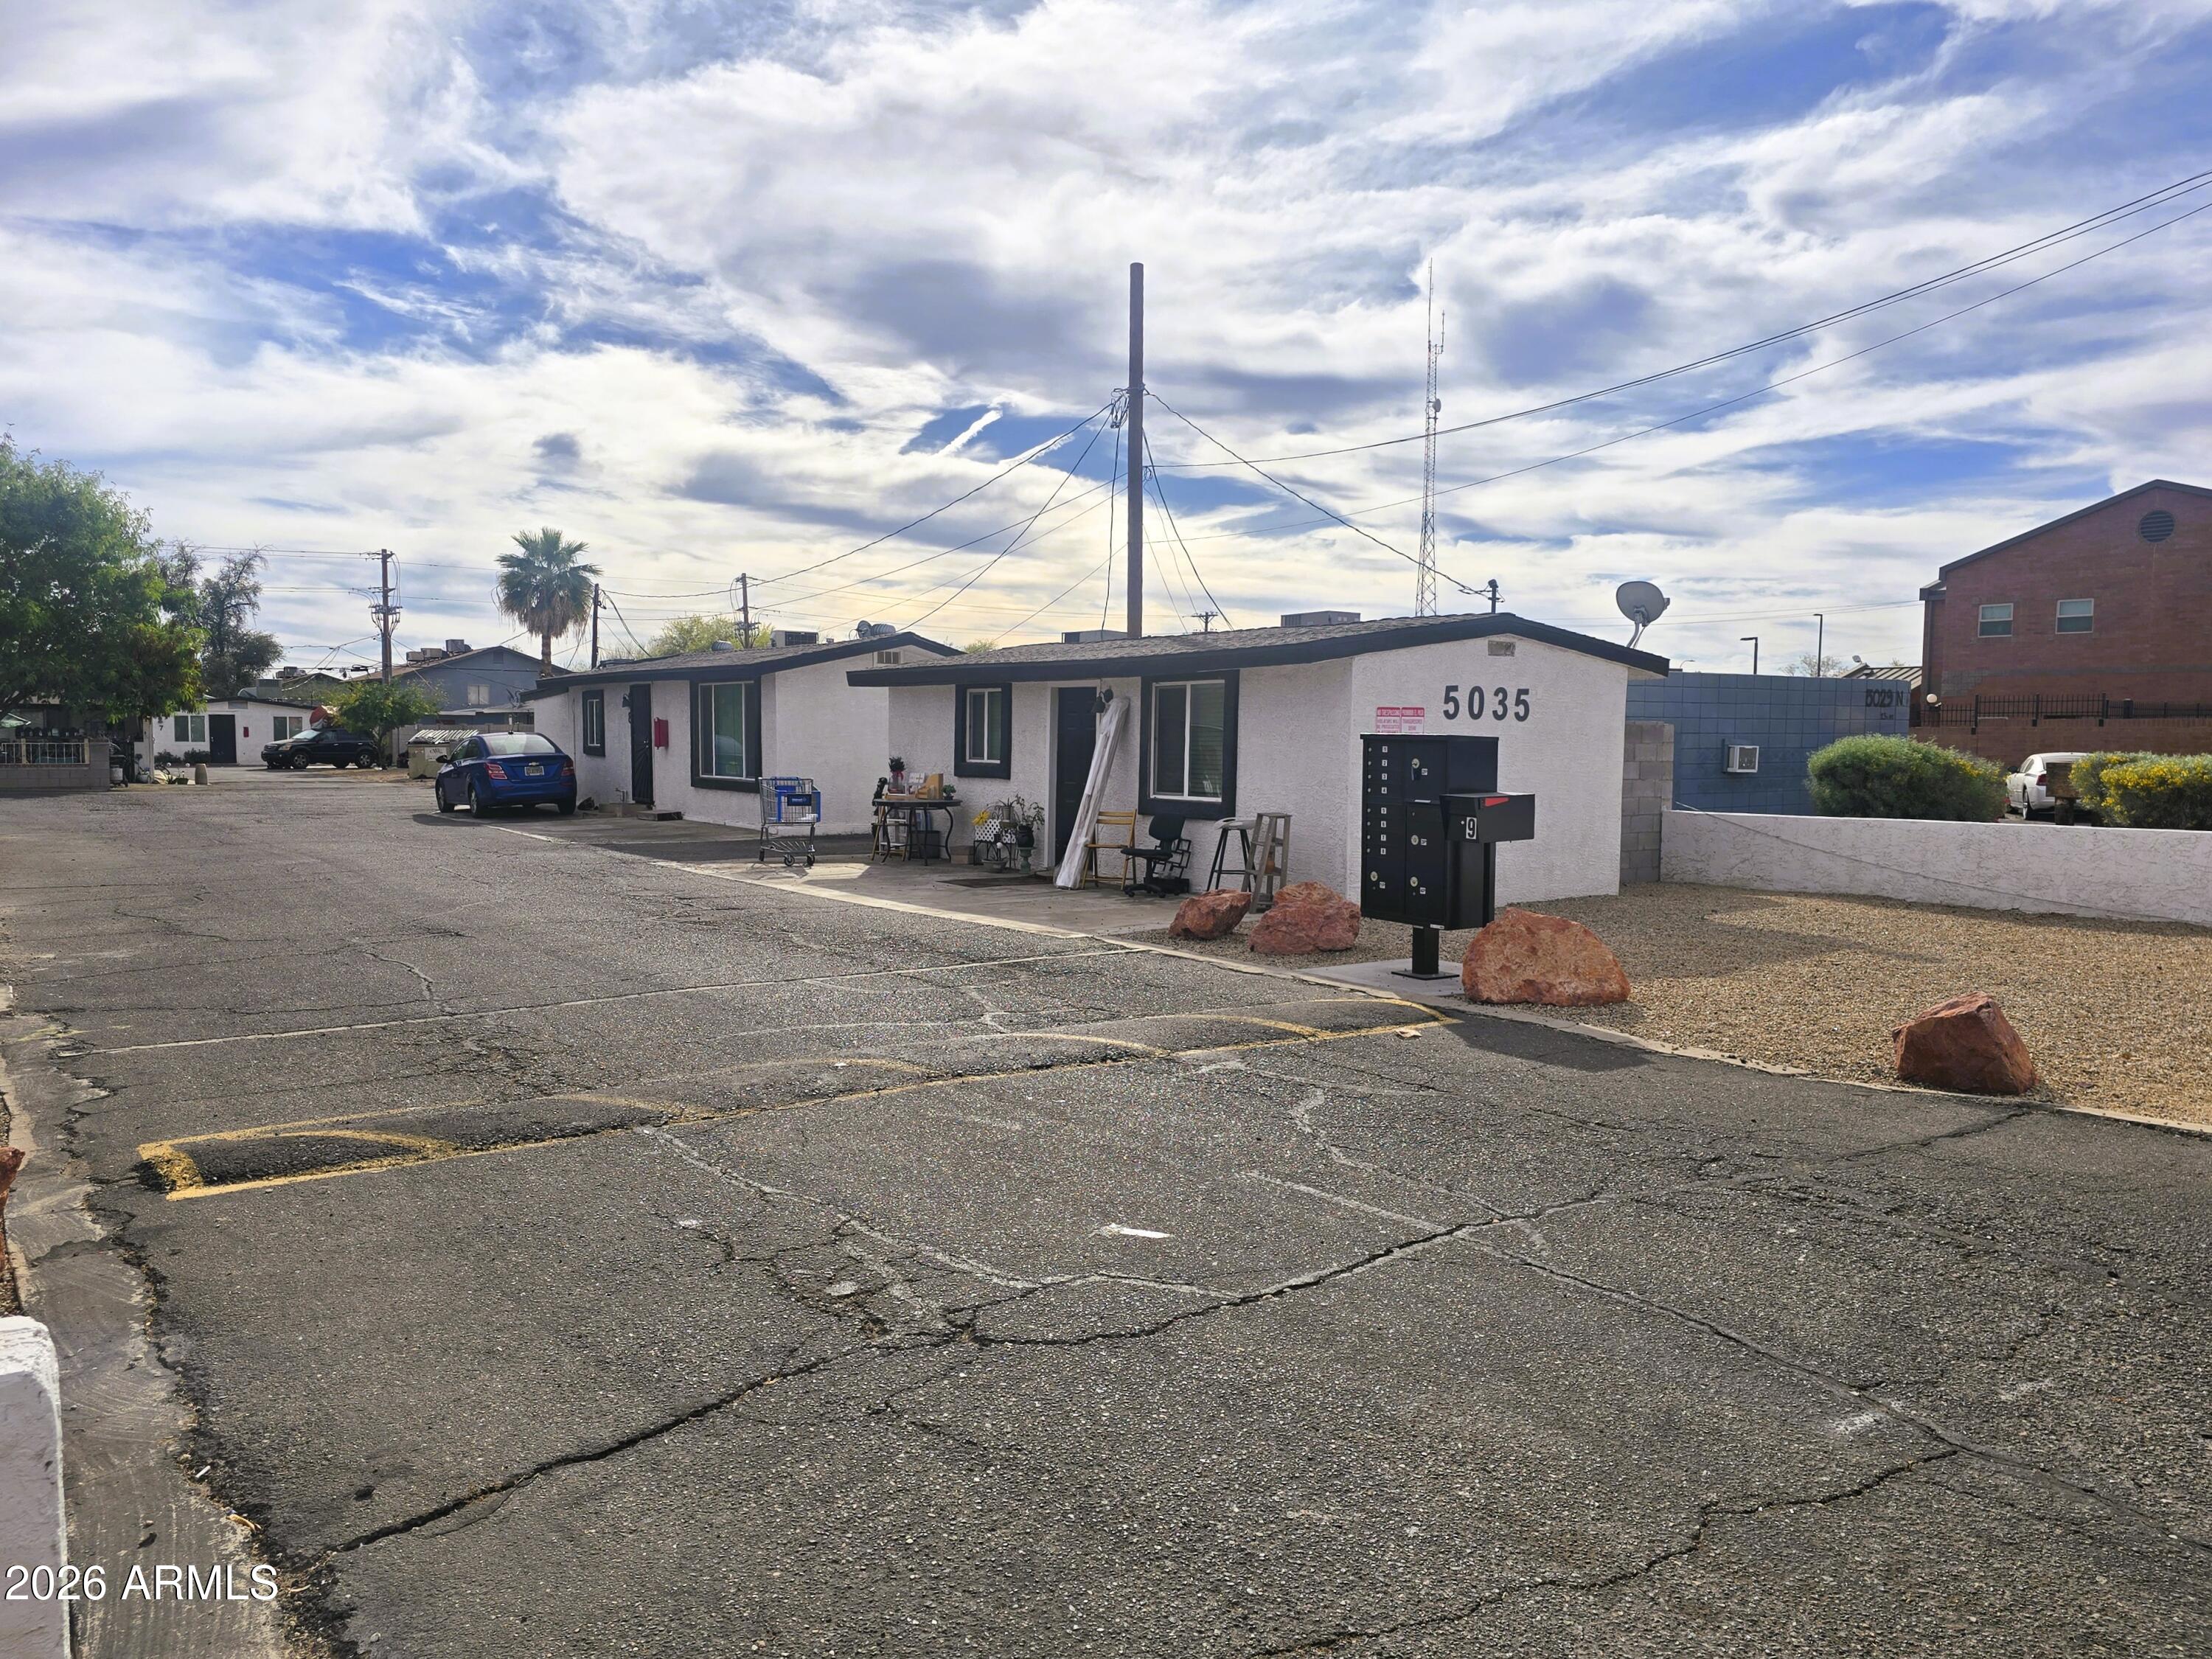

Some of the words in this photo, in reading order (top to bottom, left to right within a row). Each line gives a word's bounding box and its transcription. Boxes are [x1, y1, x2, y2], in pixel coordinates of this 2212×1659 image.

[1443, 685, 1530, 722] 5035
[1865, 689, 1893, 707] 5029
[1896, 690, 1904, 707] N
[1467, 818, 1475, 838] 9
